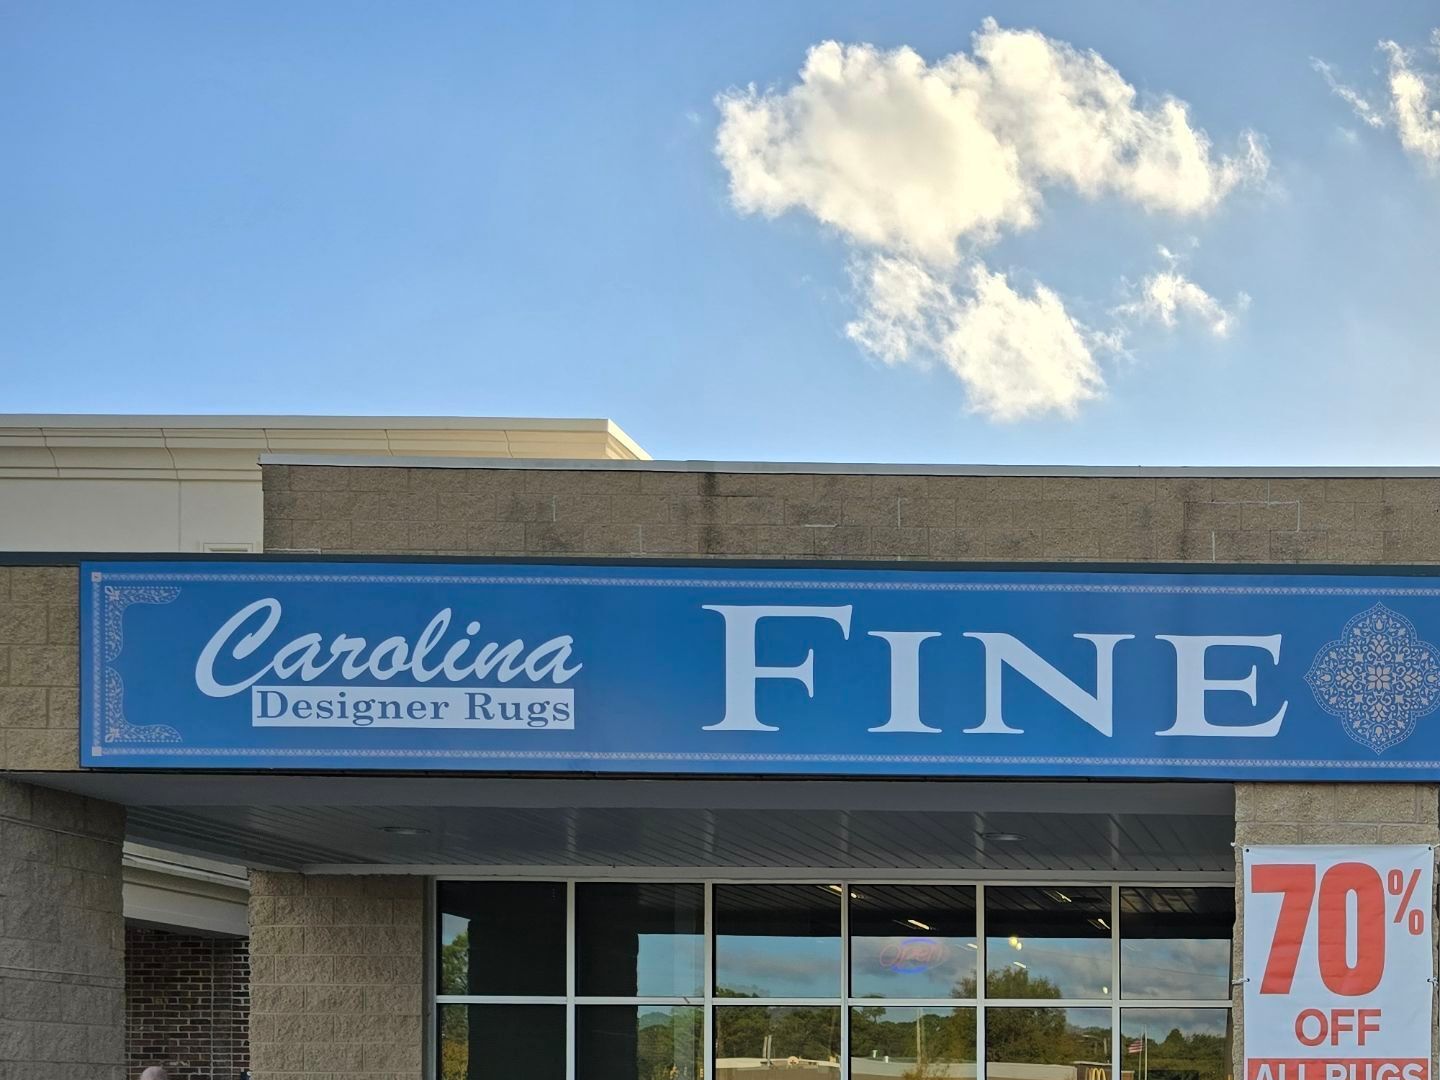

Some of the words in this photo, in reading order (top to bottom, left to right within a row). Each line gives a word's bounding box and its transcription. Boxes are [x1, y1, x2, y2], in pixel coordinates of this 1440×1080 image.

[195, 598, 583, 698] Carolina
[701, 604, 1289, 738] FINE
[256, 690, 450, 727] Designer
[464, 692, 571, 728] Rugs
[1250, 861, 1425, 997] 70%
[1294, 1008, 1382, 1047] OFF
